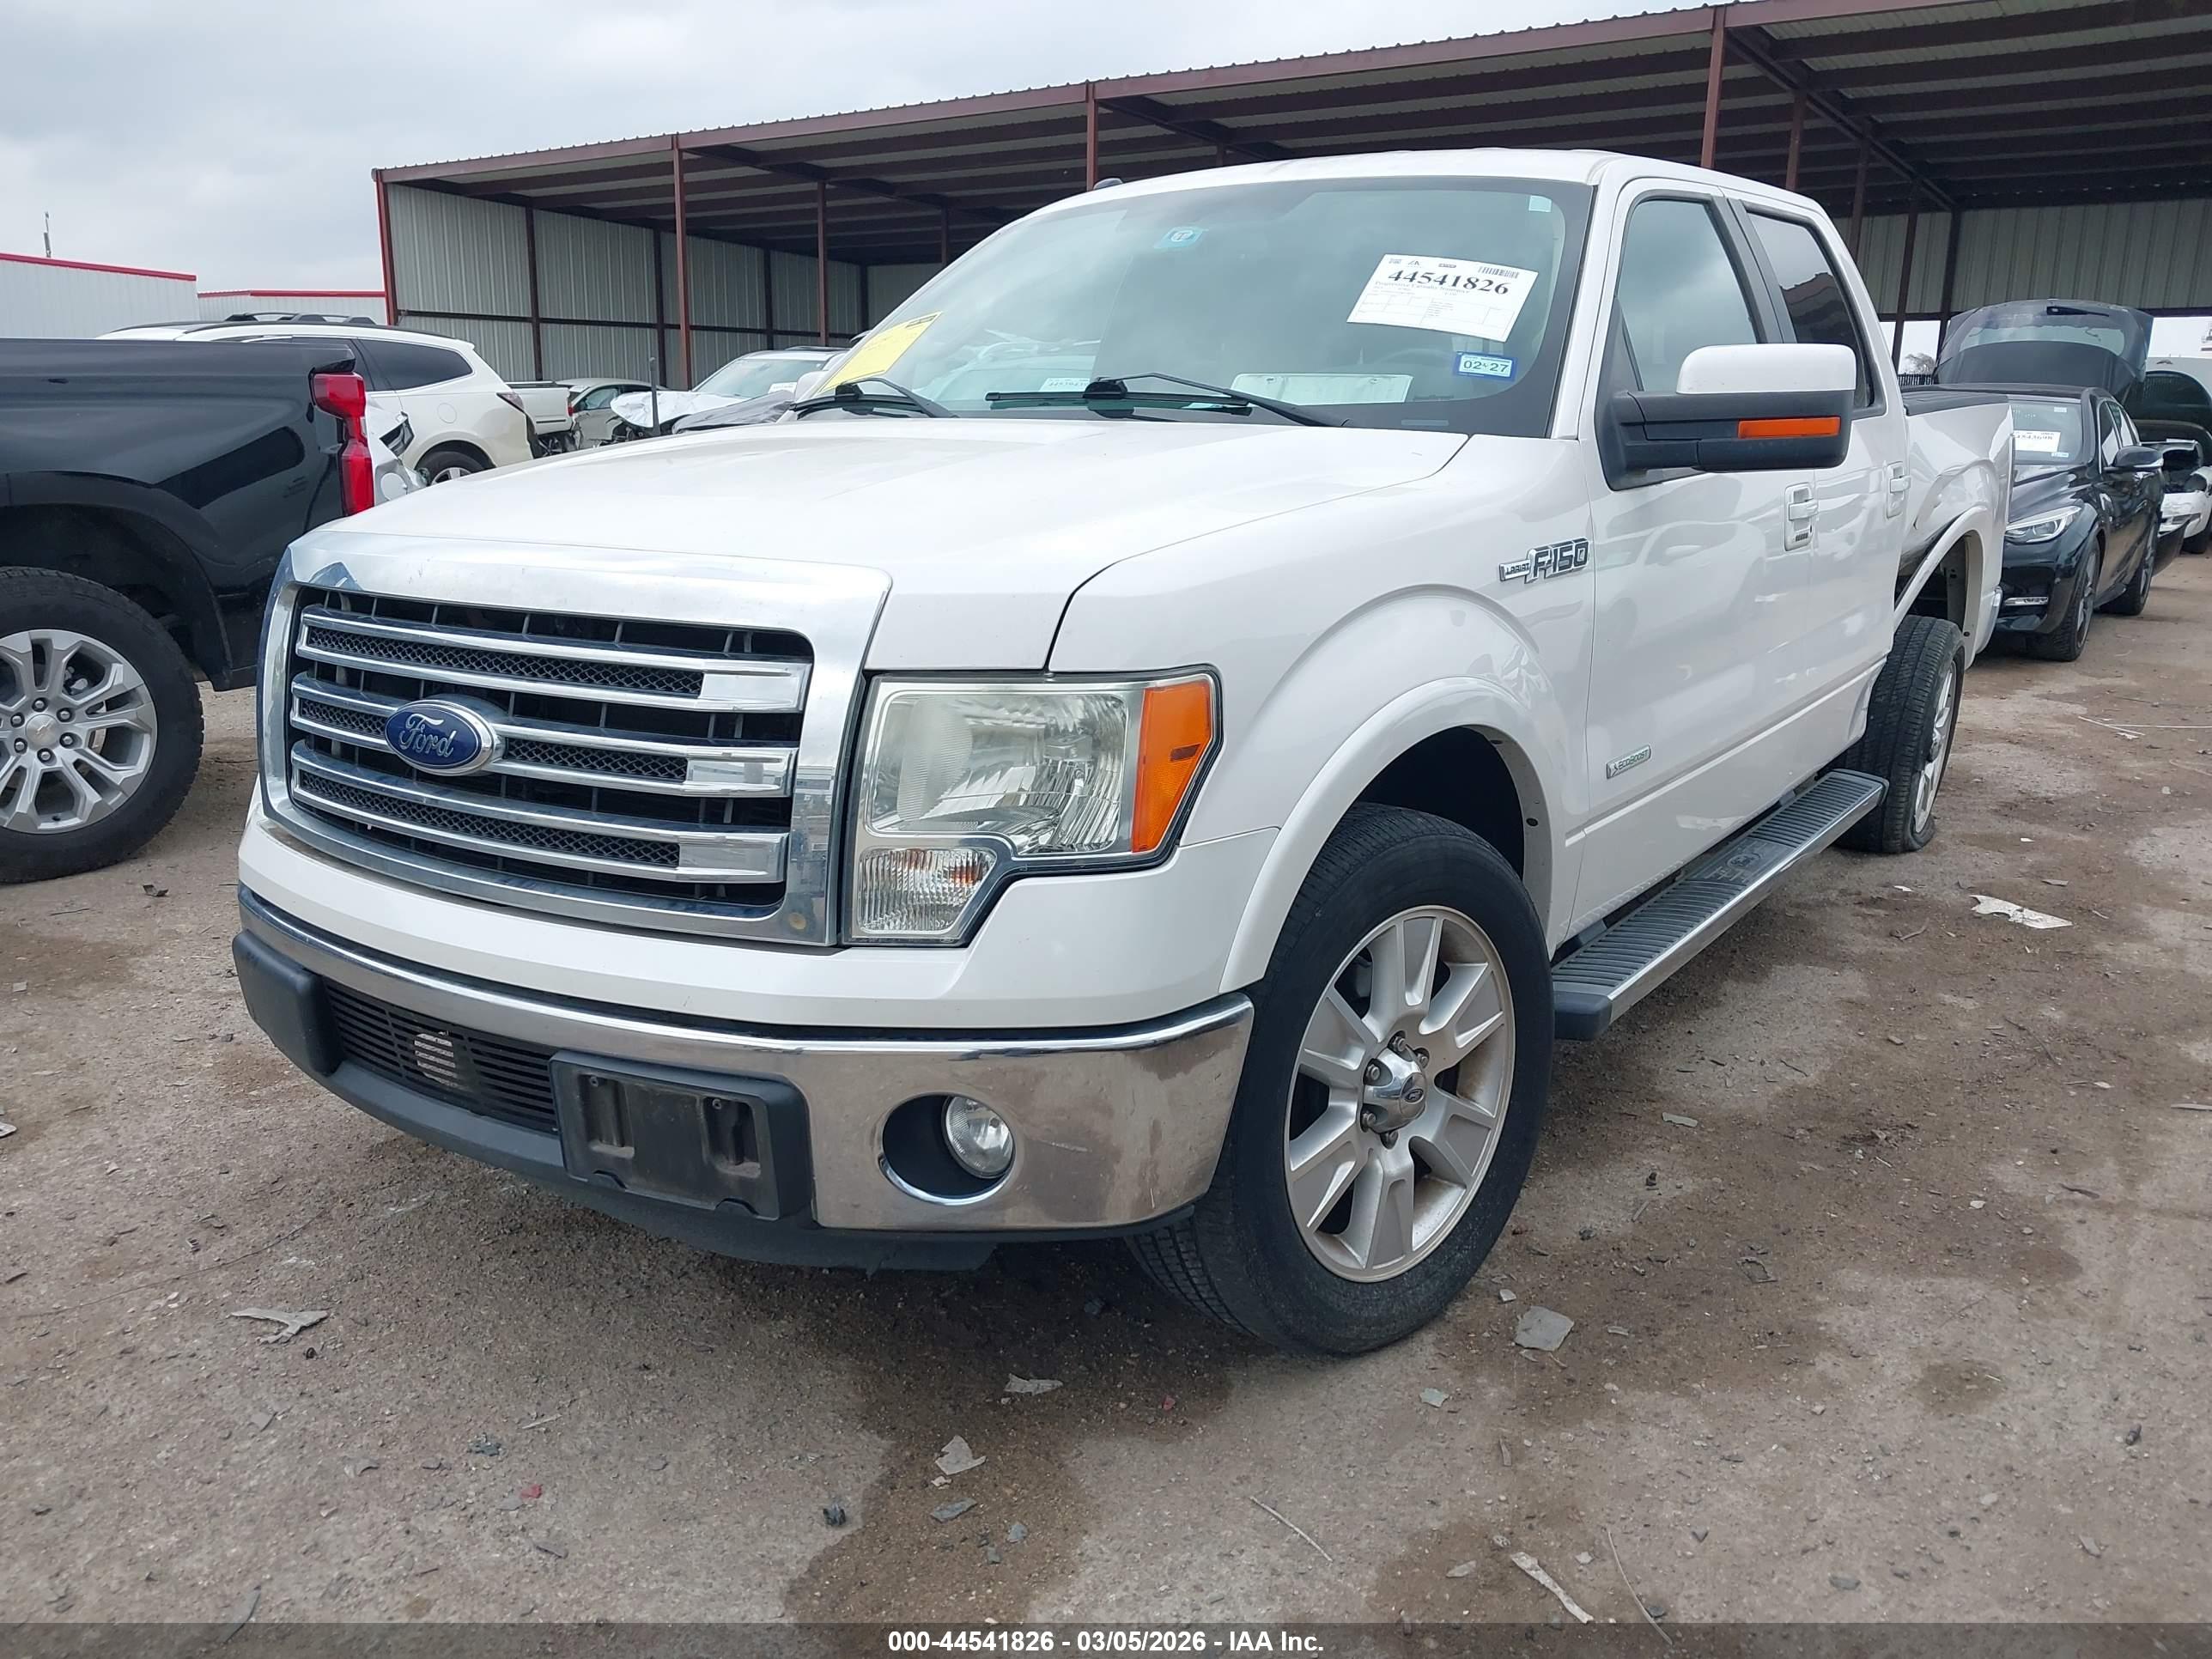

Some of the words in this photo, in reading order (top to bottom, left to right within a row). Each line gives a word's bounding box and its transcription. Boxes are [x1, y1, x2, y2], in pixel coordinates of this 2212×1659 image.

[1388, 270, 1511, 295] 44541826
[1463, 360, 1482, 370] 02
[1489, 362, 1510, 373] 27
[398, 713, 457, 758] Ford
